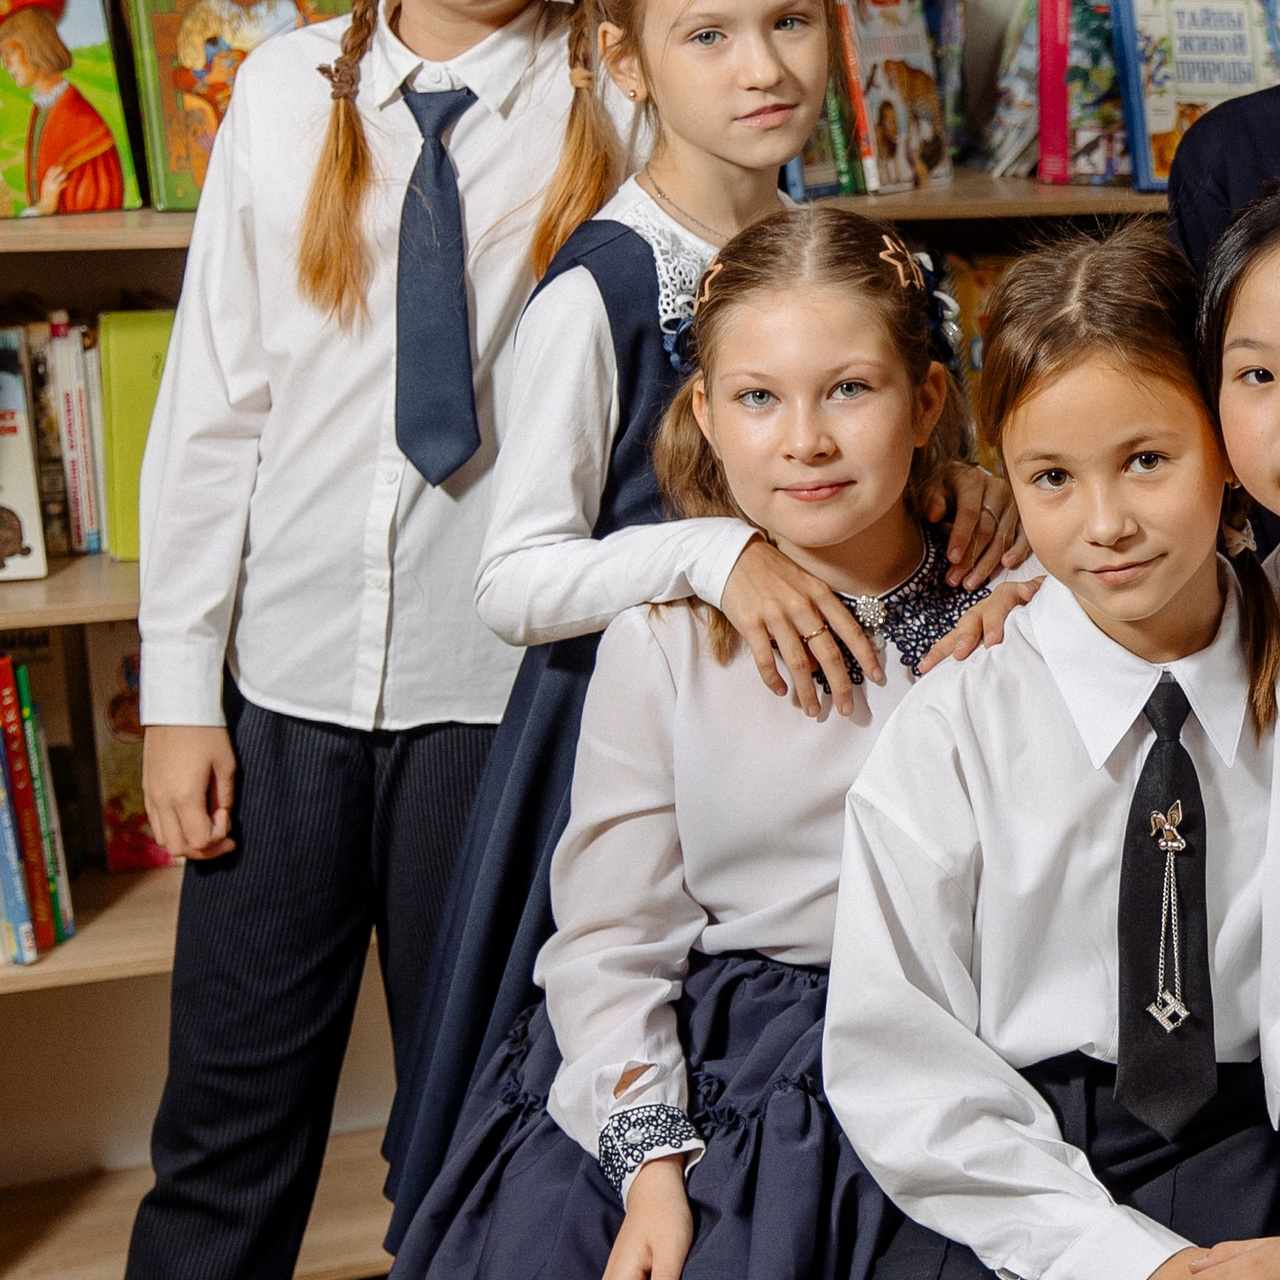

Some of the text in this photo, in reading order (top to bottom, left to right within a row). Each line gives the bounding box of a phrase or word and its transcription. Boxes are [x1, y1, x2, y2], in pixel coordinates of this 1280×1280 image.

[1174, 7, 1244, 31] ТАЙНЫ
[1177, 33, 1248, 56] ЖИВОЙ
[1174, 61, 1254, 85] ПРИРОДЫ
